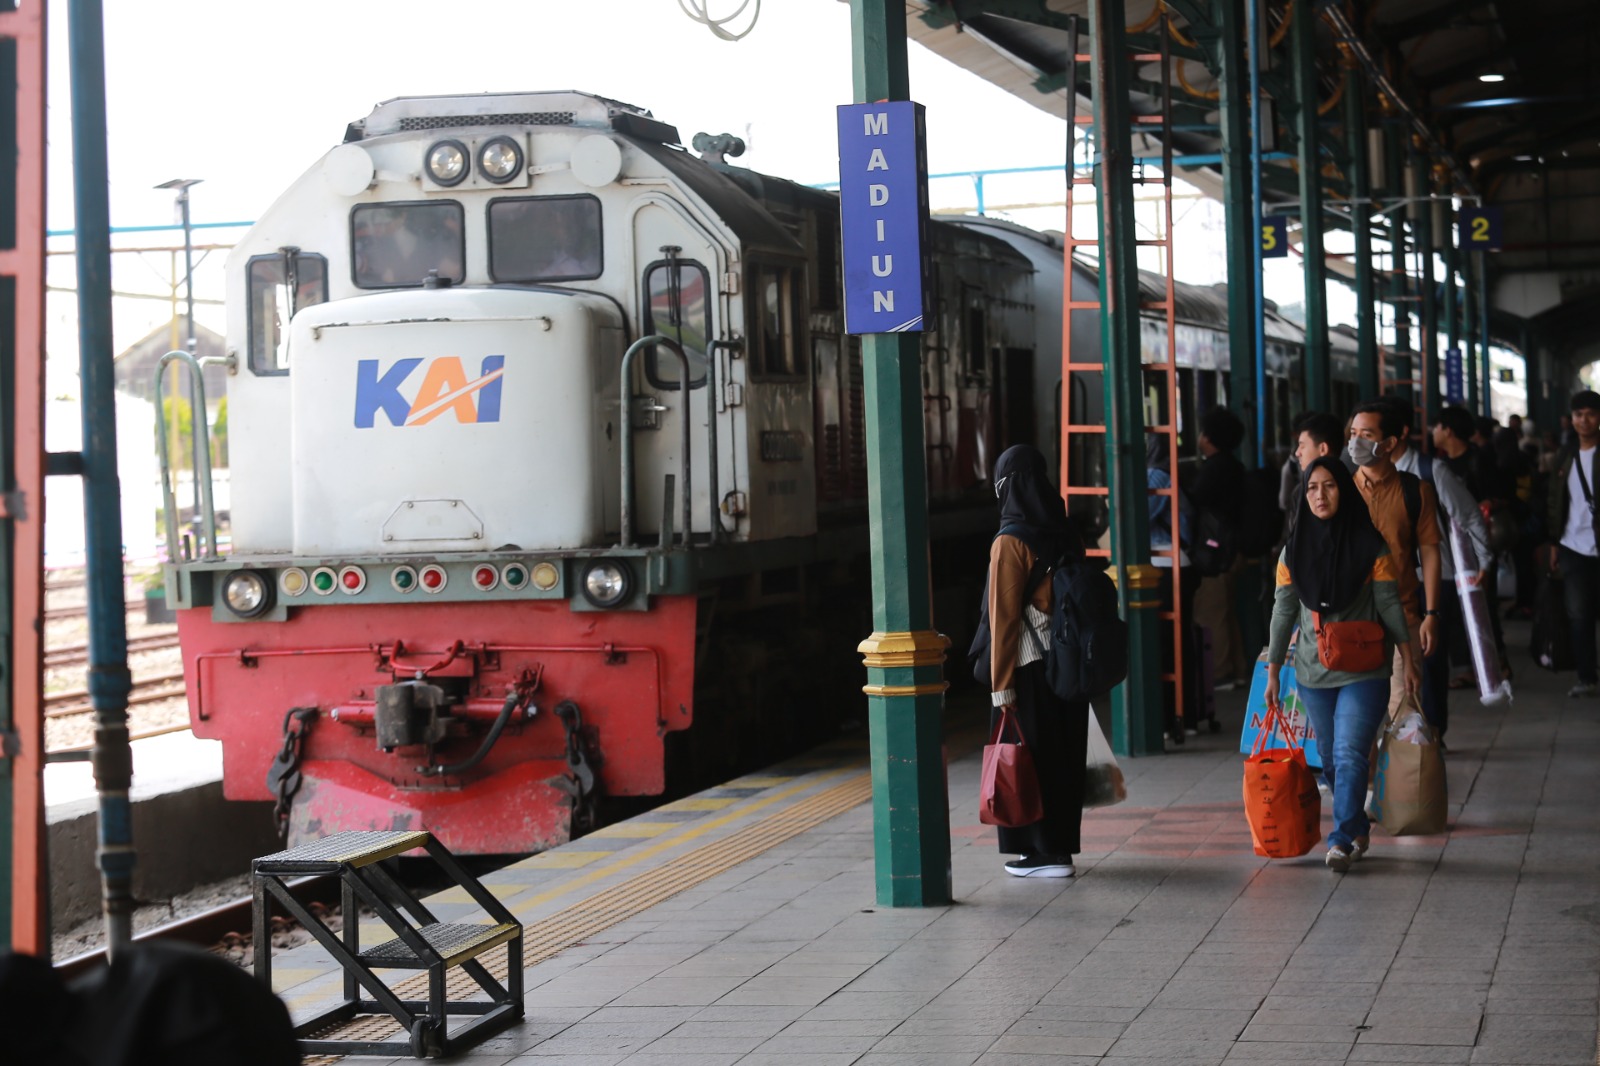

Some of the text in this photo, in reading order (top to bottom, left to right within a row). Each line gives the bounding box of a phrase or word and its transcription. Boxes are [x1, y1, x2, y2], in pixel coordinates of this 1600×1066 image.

[863, 112, 895, 313] MADIUN
[1471, 217, 1489, 241] 2
[1262, 225, 1277, 251] 3
[354, 354, 505, 429] KAI
